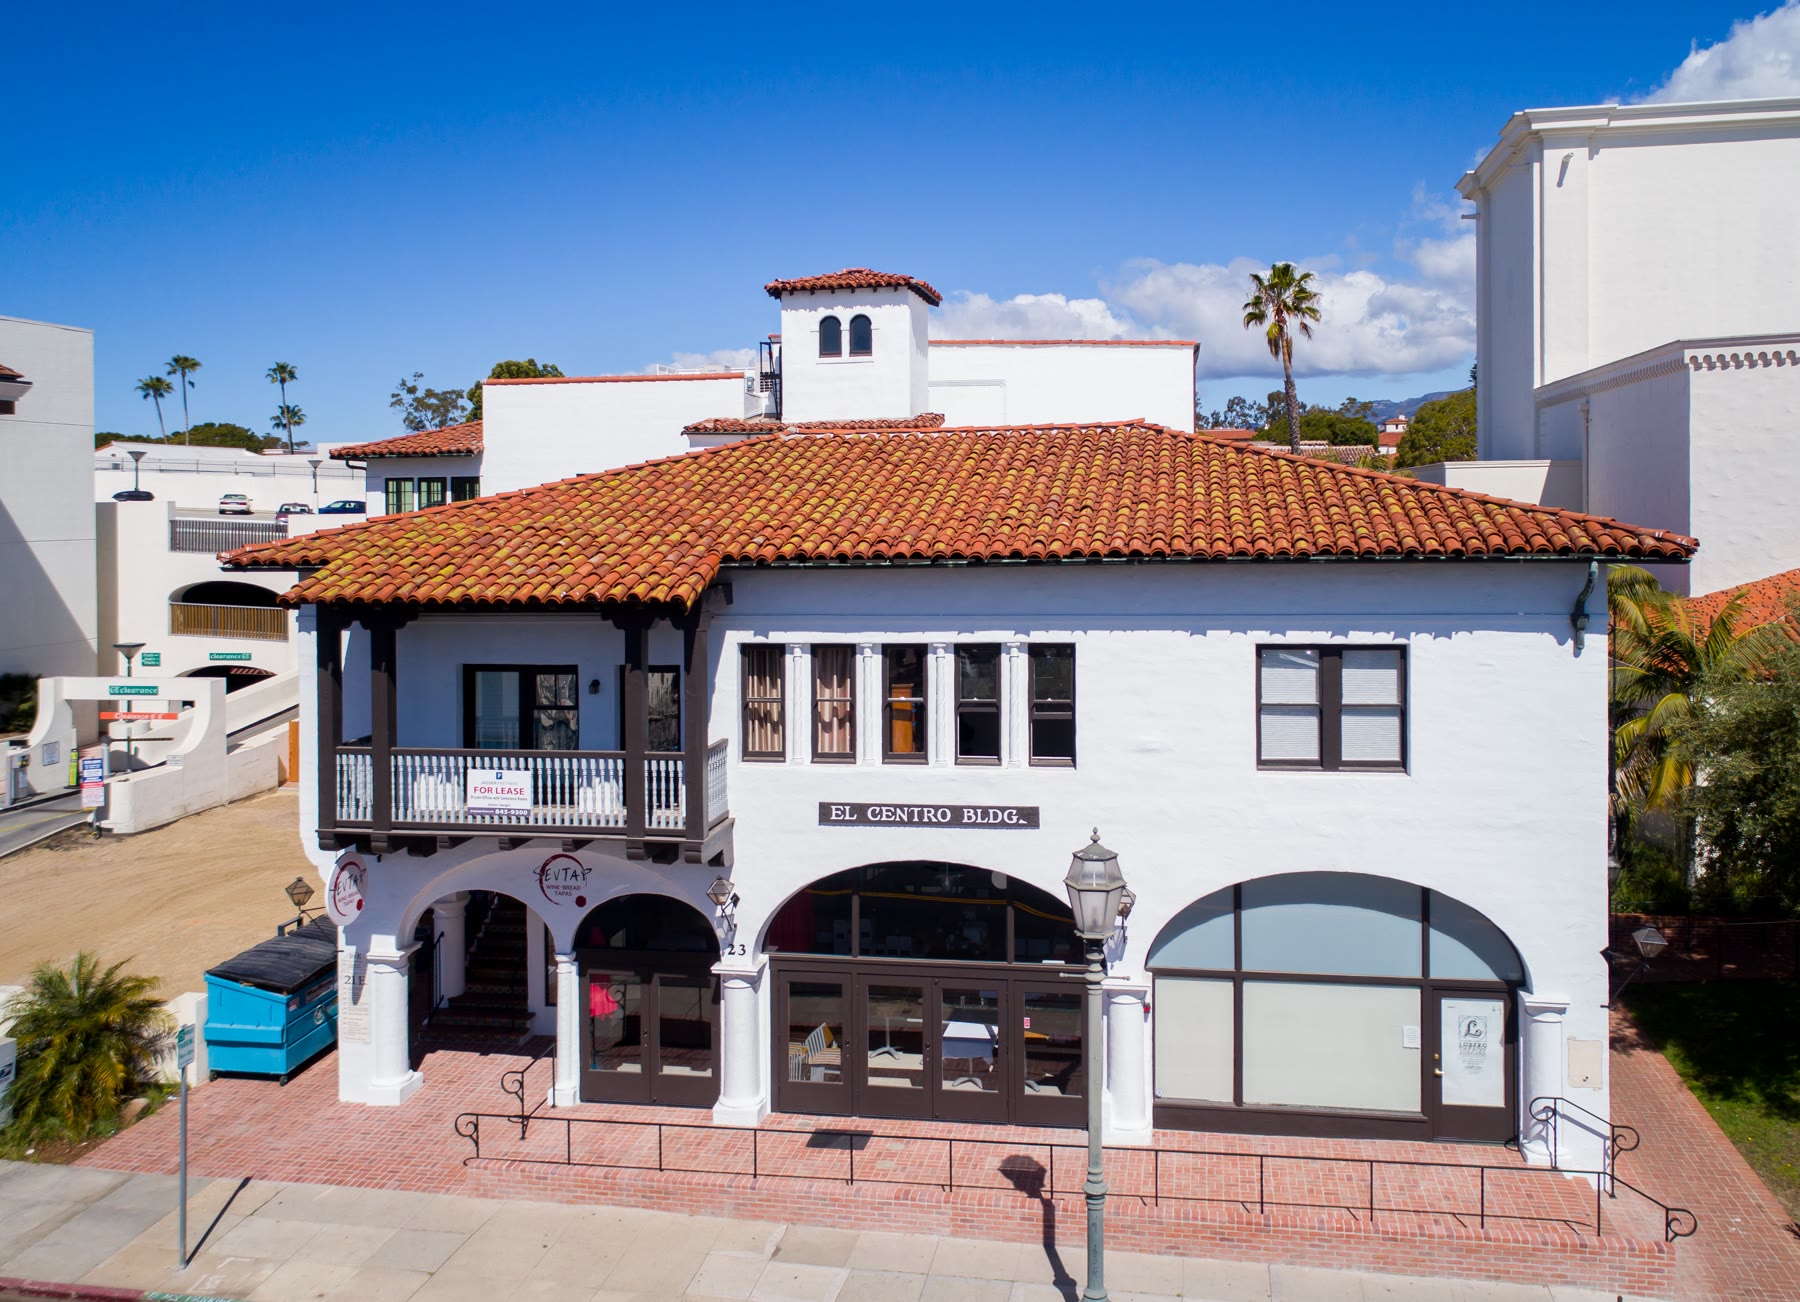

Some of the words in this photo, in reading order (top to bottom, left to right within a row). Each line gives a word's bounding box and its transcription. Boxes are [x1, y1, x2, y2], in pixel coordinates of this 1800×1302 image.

[120, 686, 158, 694] clearance
[114, 712, 149, 720] Clearance
[473, 786, 493, 794] FOR
[495, 787, 525, 796] LEASE
[830, 805, 857, 821] EL
[867, 805, 951, 823] CENTRO
[962, 807, 1028, 825] BLDG.
[532, 865, 593, 882] SEVTAP
[727, 943, 747, 956] 23
